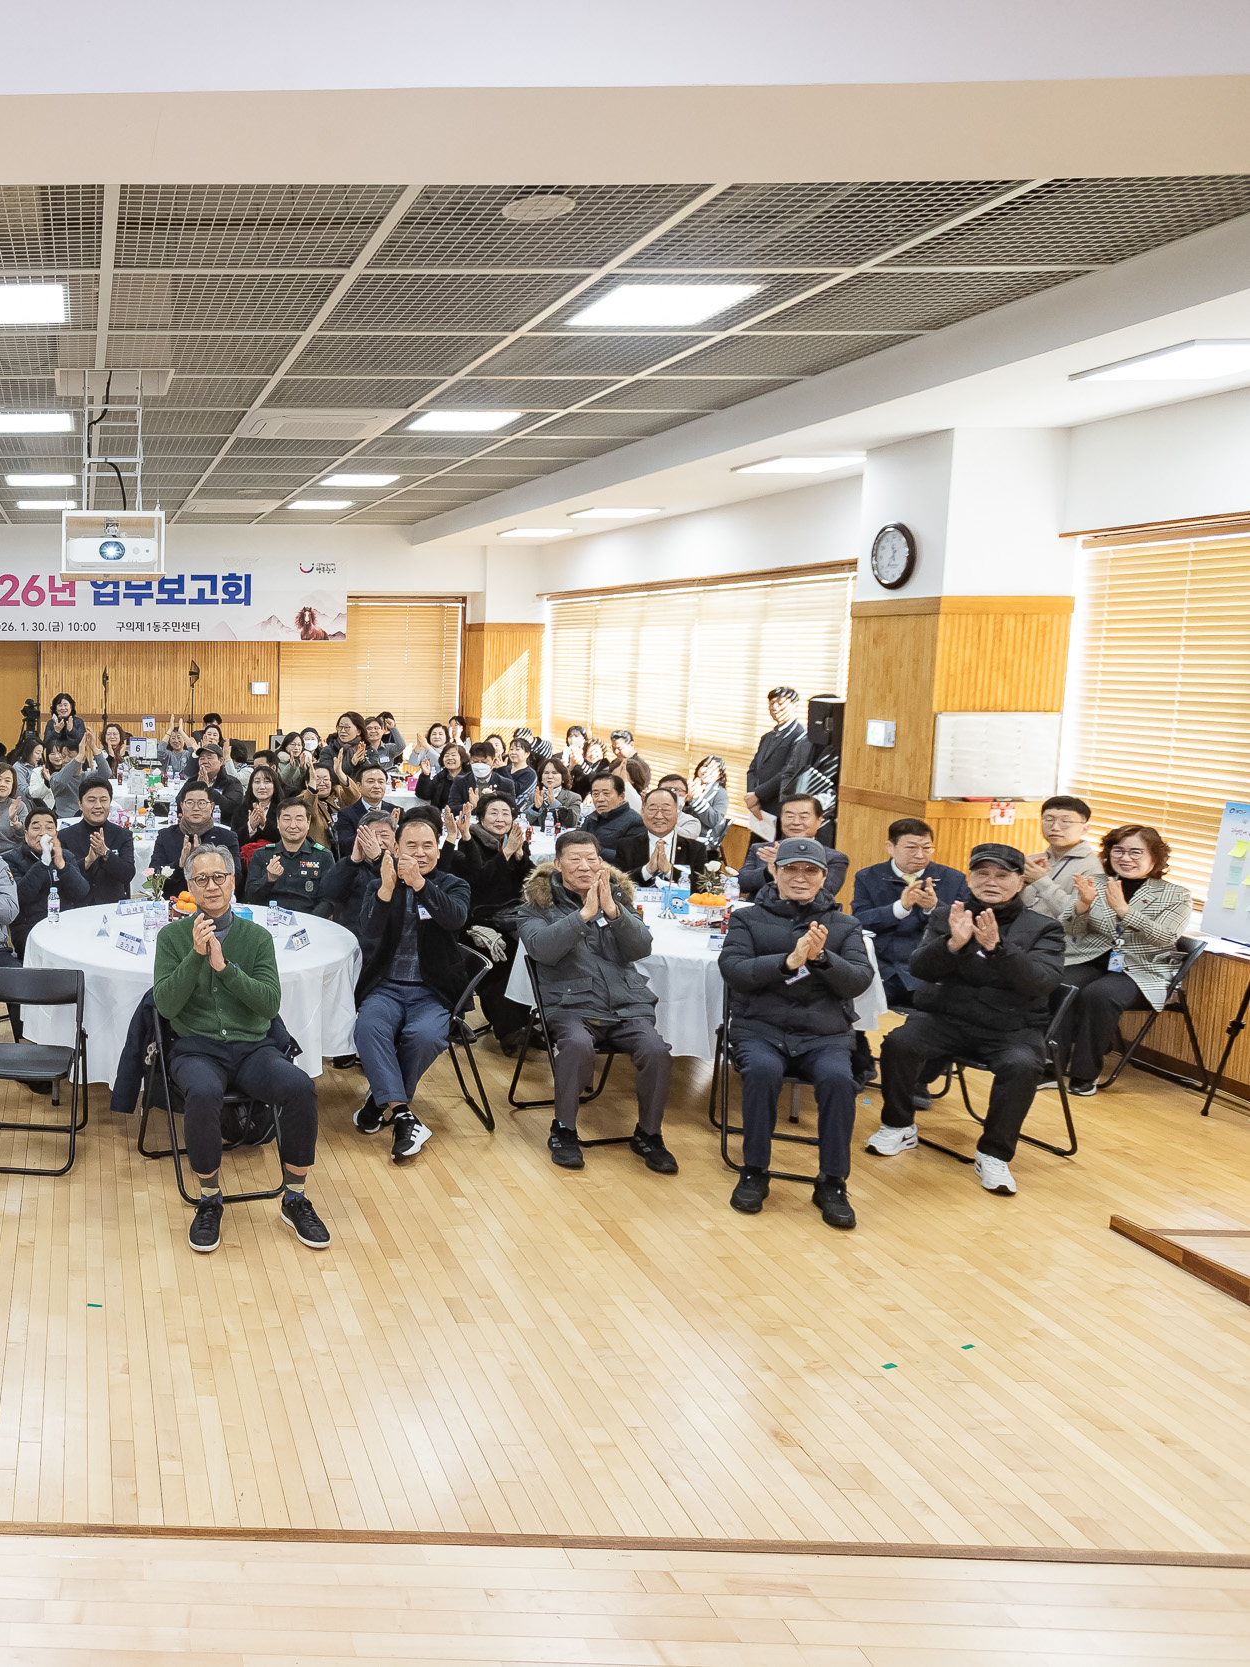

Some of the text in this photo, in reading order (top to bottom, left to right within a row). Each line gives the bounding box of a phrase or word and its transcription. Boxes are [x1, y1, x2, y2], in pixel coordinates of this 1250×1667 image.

[90, 573, 252, 607] 업무보고회
[20, 621, 30, 632] 1.
[67, 621, 97, 632] 10:00
